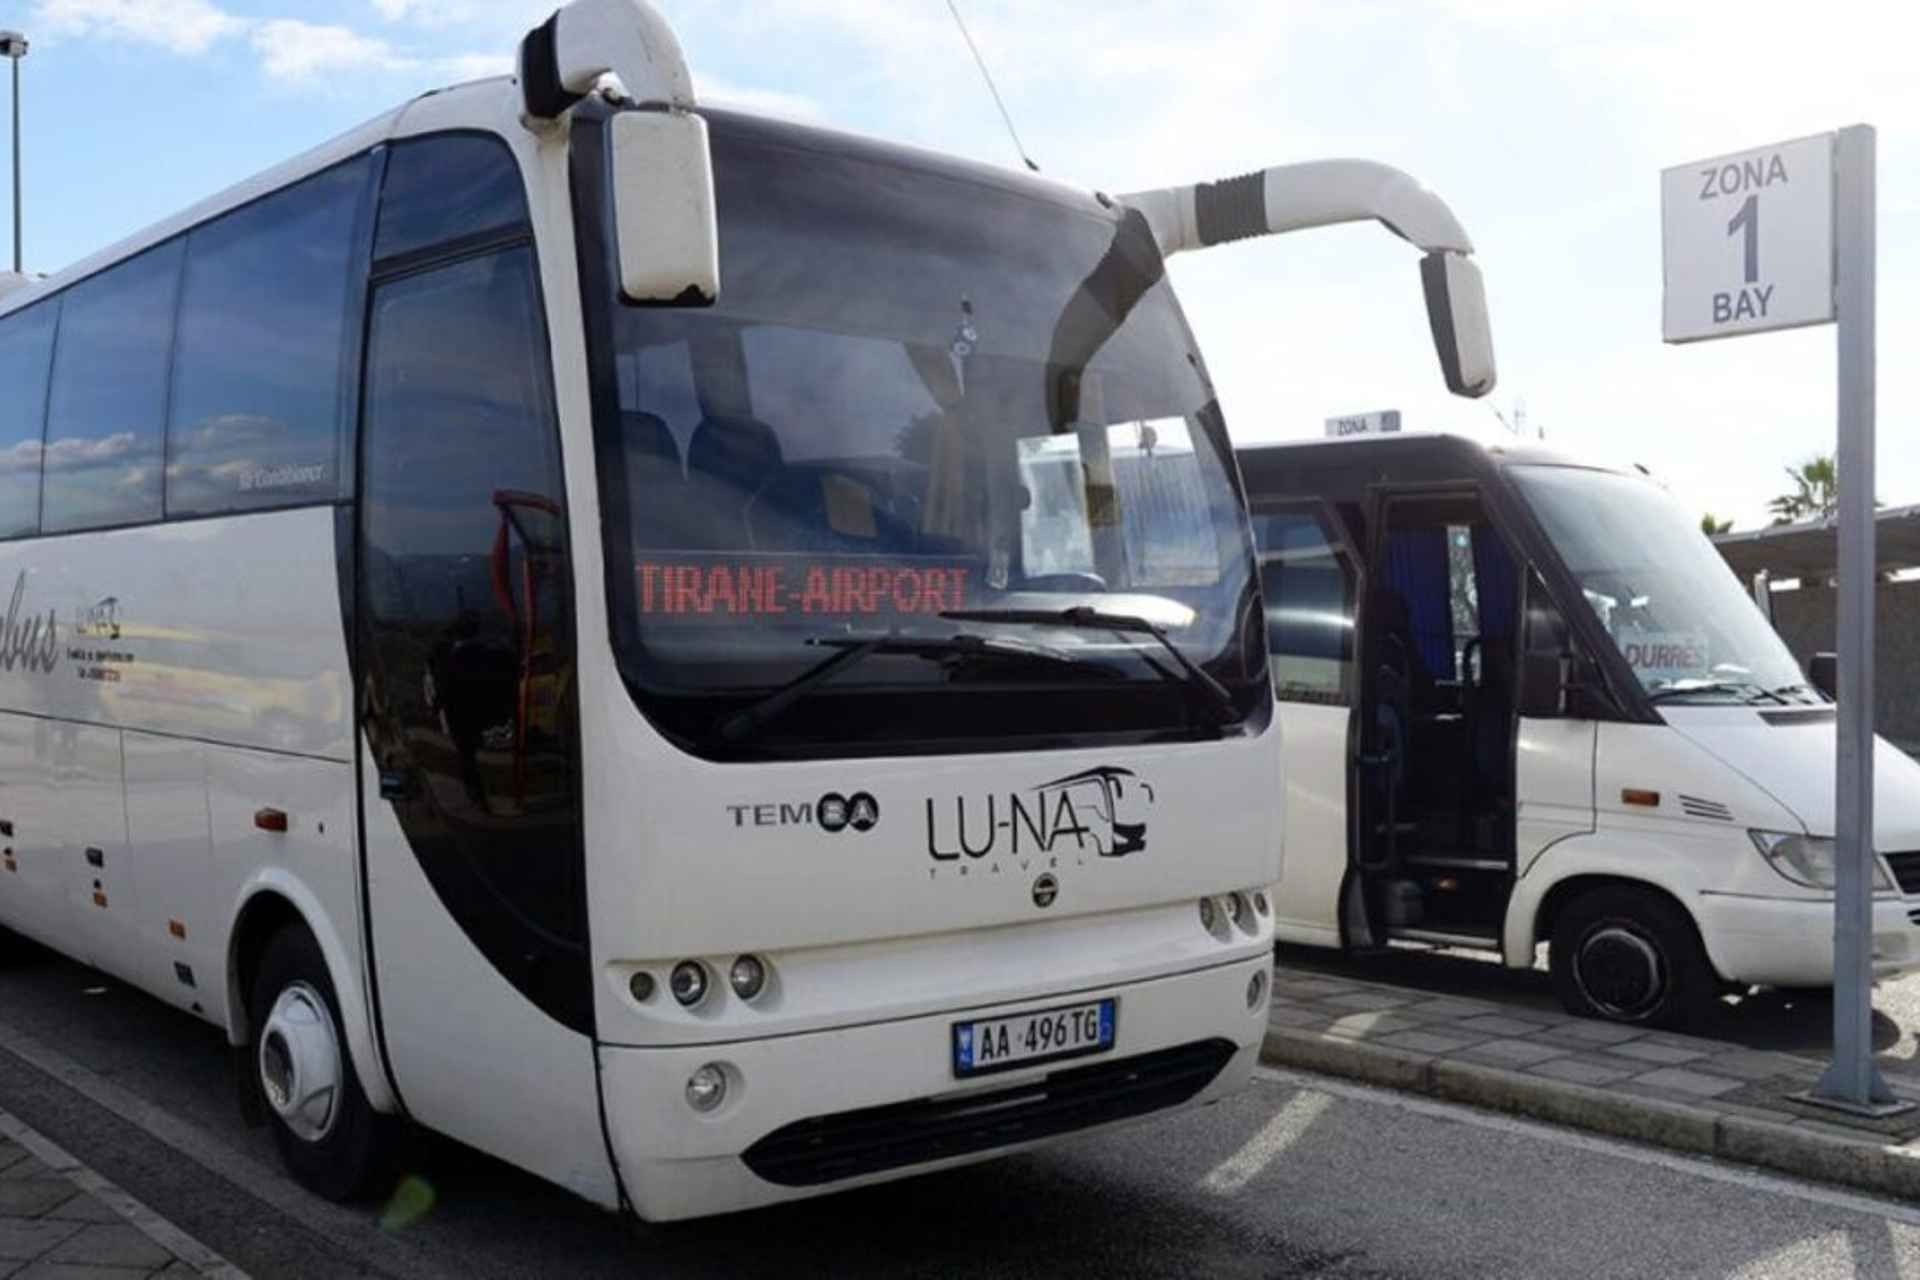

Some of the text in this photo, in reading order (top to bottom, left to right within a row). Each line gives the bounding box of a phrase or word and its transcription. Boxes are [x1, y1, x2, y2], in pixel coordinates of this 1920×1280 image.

[1698, 153, 1788, 201] ZONA
[1727, 194, 1759, 284] 1
[1712, 284, 1774, 324] BAY
[927, 789, 1090, 861] LU-NA
[980, 1024, 1010, 1061] AA
